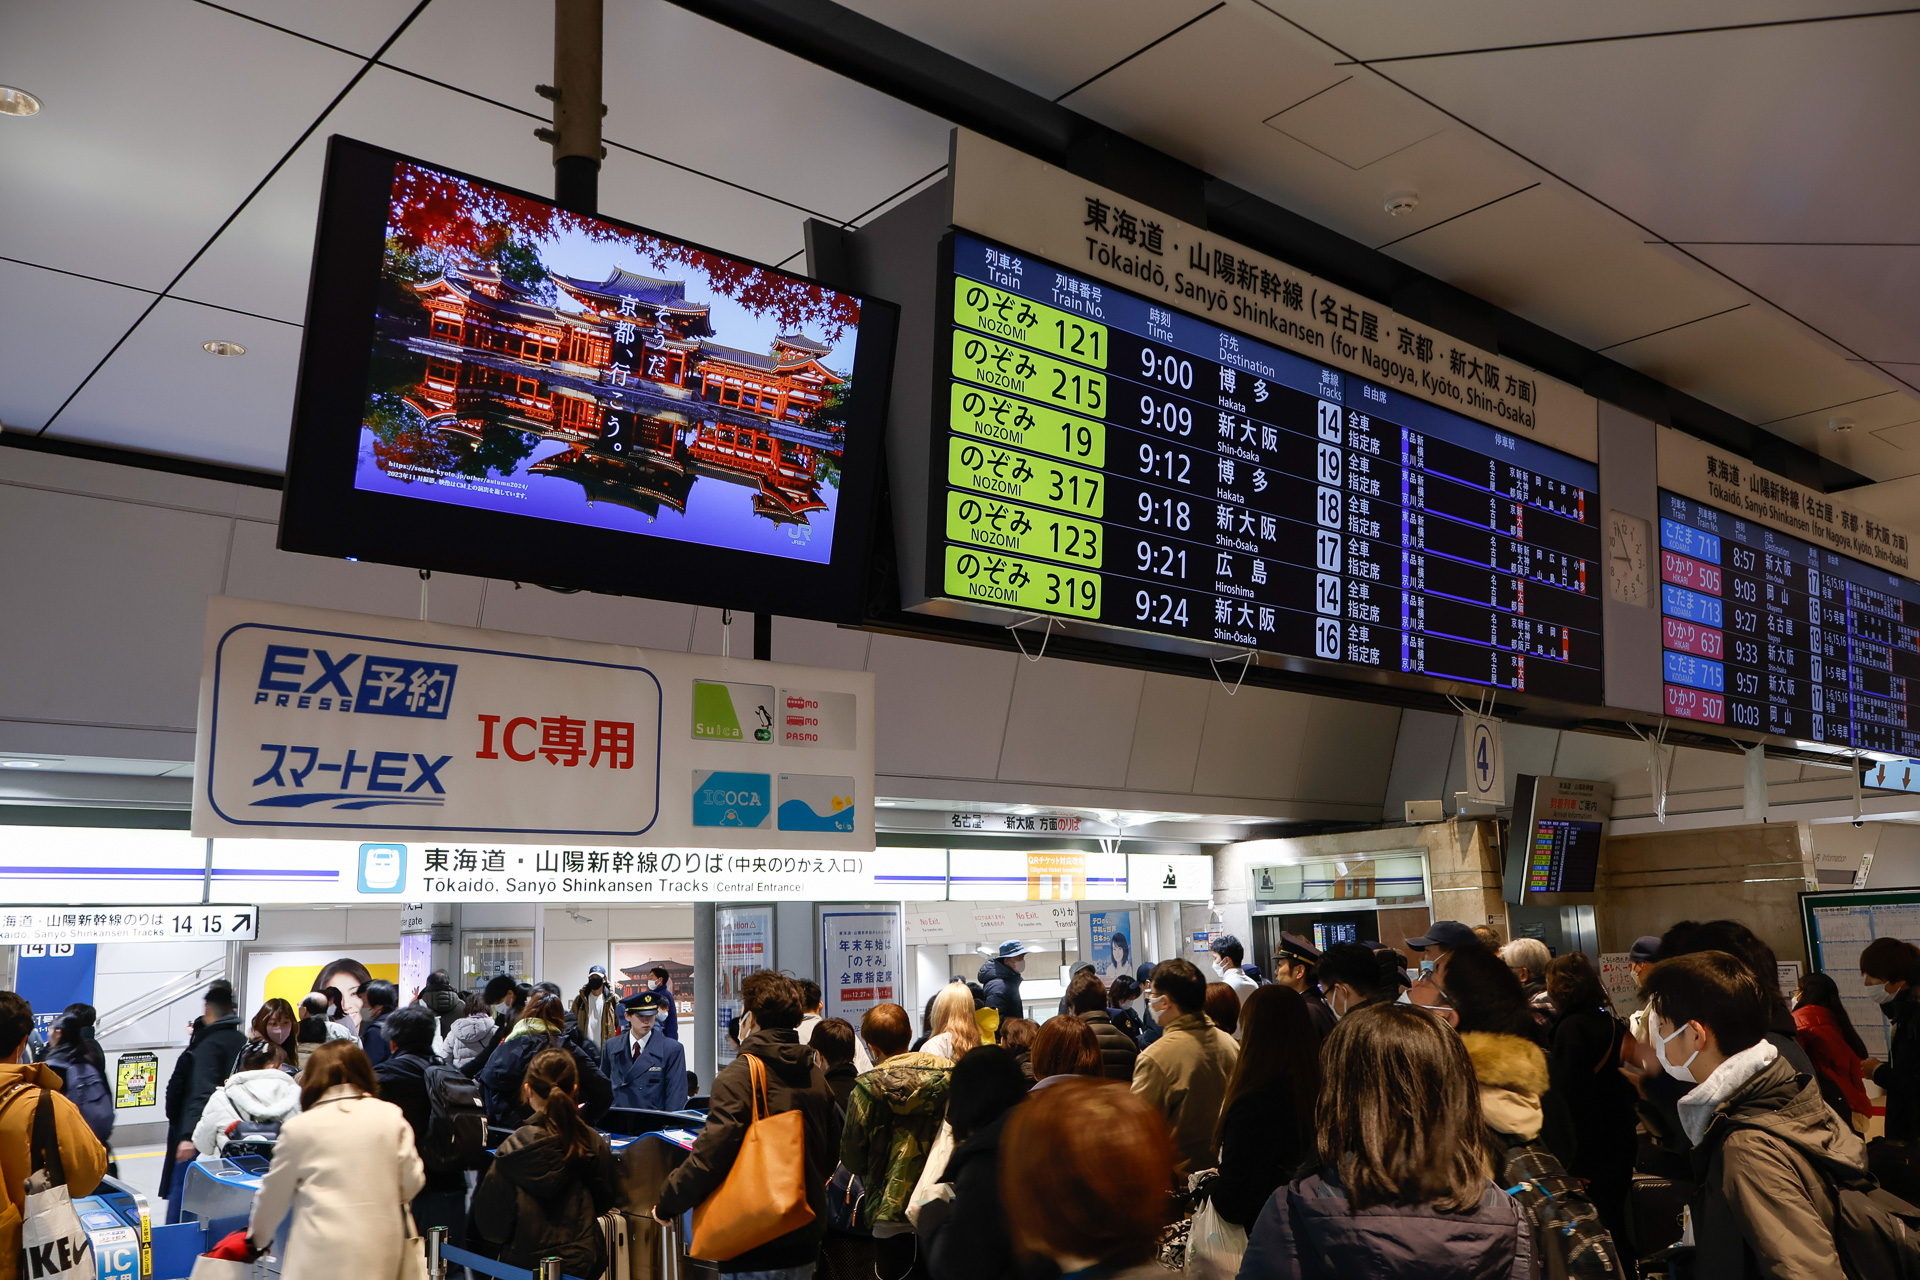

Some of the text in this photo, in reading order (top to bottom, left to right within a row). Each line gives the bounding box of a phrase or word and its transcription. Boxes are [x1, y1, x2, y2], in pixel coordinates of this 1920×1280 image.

[985, 248, 1023, 275] 列車名
[987, 266, 1021, 290] Train
[1055, 273, 1103, 303] 列車番号
[1051, 288, 1106, 319] Train No.
[966, 287, 1100, 361] のぞみ 121
[978, 315, 1027, 342] NOZOMI
[1149, 307, 1171, 328] 時刻
[648, 305, 671, 379] そうだ
[1086, 236, 1536, 430] Tōkaidō, Sanyō Shinkansen (for Nagoya, Kyōto, Shin-Ōsaka)
[1146, 321, 1174, 342] Time
[1219, 332, 1239, 352] 行先
[964, 339, 1101, 409] のぞみ 215
[1141, 347, 1193, 390] 9:00
[1218, 348, 1276, 379] Destination
[976, 367, 1025, 393] NOZOMI
[1321, 370, 1339, 387] 番線
[1318, 382, 1342, 401] Tracks
[1363, 385, 1387, 404] 自由席
[1140, 395, 1192, 437] 9:09
[1218, 395, 1246, 413] Hakata
[962, 392, 1093, 457] のぞみ 19
[974, 420, 1024, 445] NOZOMI
[1319, 405, 1340, 439] 14
[1348, 411, 1370, 432] 全車
[1217, 441, 1260, 463] Shin-Ōsaka
[1348, 432, 1381, 455] 指定席
[1139, 443, 1191, 485] 9:12
[1319, 448, 1340, 481] 19
[1348, 453, 1370, 474] 全車
[960, 446, 1099, 509] のぞみ 317
[972, 474, 1022, 497] NOZOMI
[1348, 473, 1381, 497] 指定席
[1217, 488, 1245, 504] Hakata
[1319, 491, 1339, 524] 18
[1348, 495, 1370, 516] 全車
[1138, 491, 1191, 532] 9:18
[1769, 506, 1810, 532] Shinkansen
[958, 499, 1097, 560] のぞみ 123
[1348, 514, 1381, 538] 指定席
[971, 528, 1020, 550] NOZOMI
[1215, 533, 1259, 553] Shin-Ōsaka
[1318, 534, 1339, 567] 17
[1347, 537, 1370, 558] 全車
[1666, 521, 1718, 560] こだま 711
[1136, 541, 1187, 579] 9:21
[1347, 557, 1381, 581] 指定席
[1733, 547, 1755, 571] 8:57
[956, 553, 1096, 611] のぞみ 319
[1666, 555, 1720, 591] ひかり 505
[969, 582, 1018, 603] NOZOMI
[1215, 581, 1255, 599] Hiroshima
[1318, 578, 1339, 611] 14
[1347, 580, 1370, 600] 全車
[1734, 578, 1756, 602] 9:03
[1135, 589, 1188, 628] 9:24
[1347, 599, 1381, 623] 指定席
[1668, 588, 1720, 623] こだま 713
[1347, 623, 1370, 643] 全車
[1735, 609, 1757, 633] 9:27
[1214, 628, 1257, 645] Shin-Ōsaka
[1317, 622, 1338, 655] 16
[1667, 621, 1721, 655] ひかり 637
[1347, 643, 1380, 665] 指定席
[1735, 640, 1758, 664] 9:33
[1669, 654, 1722, 687] こだま 715
[1736, 672, 1759, 695] 9:57
[253, 691, 353, 713] PRESS
[1669, 688, 1722, 719] ひかり 507
[1731, 703, 1760, 726] 10:03
[476, 713, 635, 770] IC専用
[696, 723, 740, 737] Suica
[786, 732, 818, 742] PASMO
[252, 743, 454, 794] スマートEX
[1477, 736, 1489, 782] 4
[703, 789, 762, 806] ICOCA
[506, 877, 556, 895] Sanyō
[562, 878, 653, 892] Shinkansen
[658, 878, 709, 892] Tracks
[172, 915, 222, 933] 14 15
[104, 1248, 132, 1273] IC
